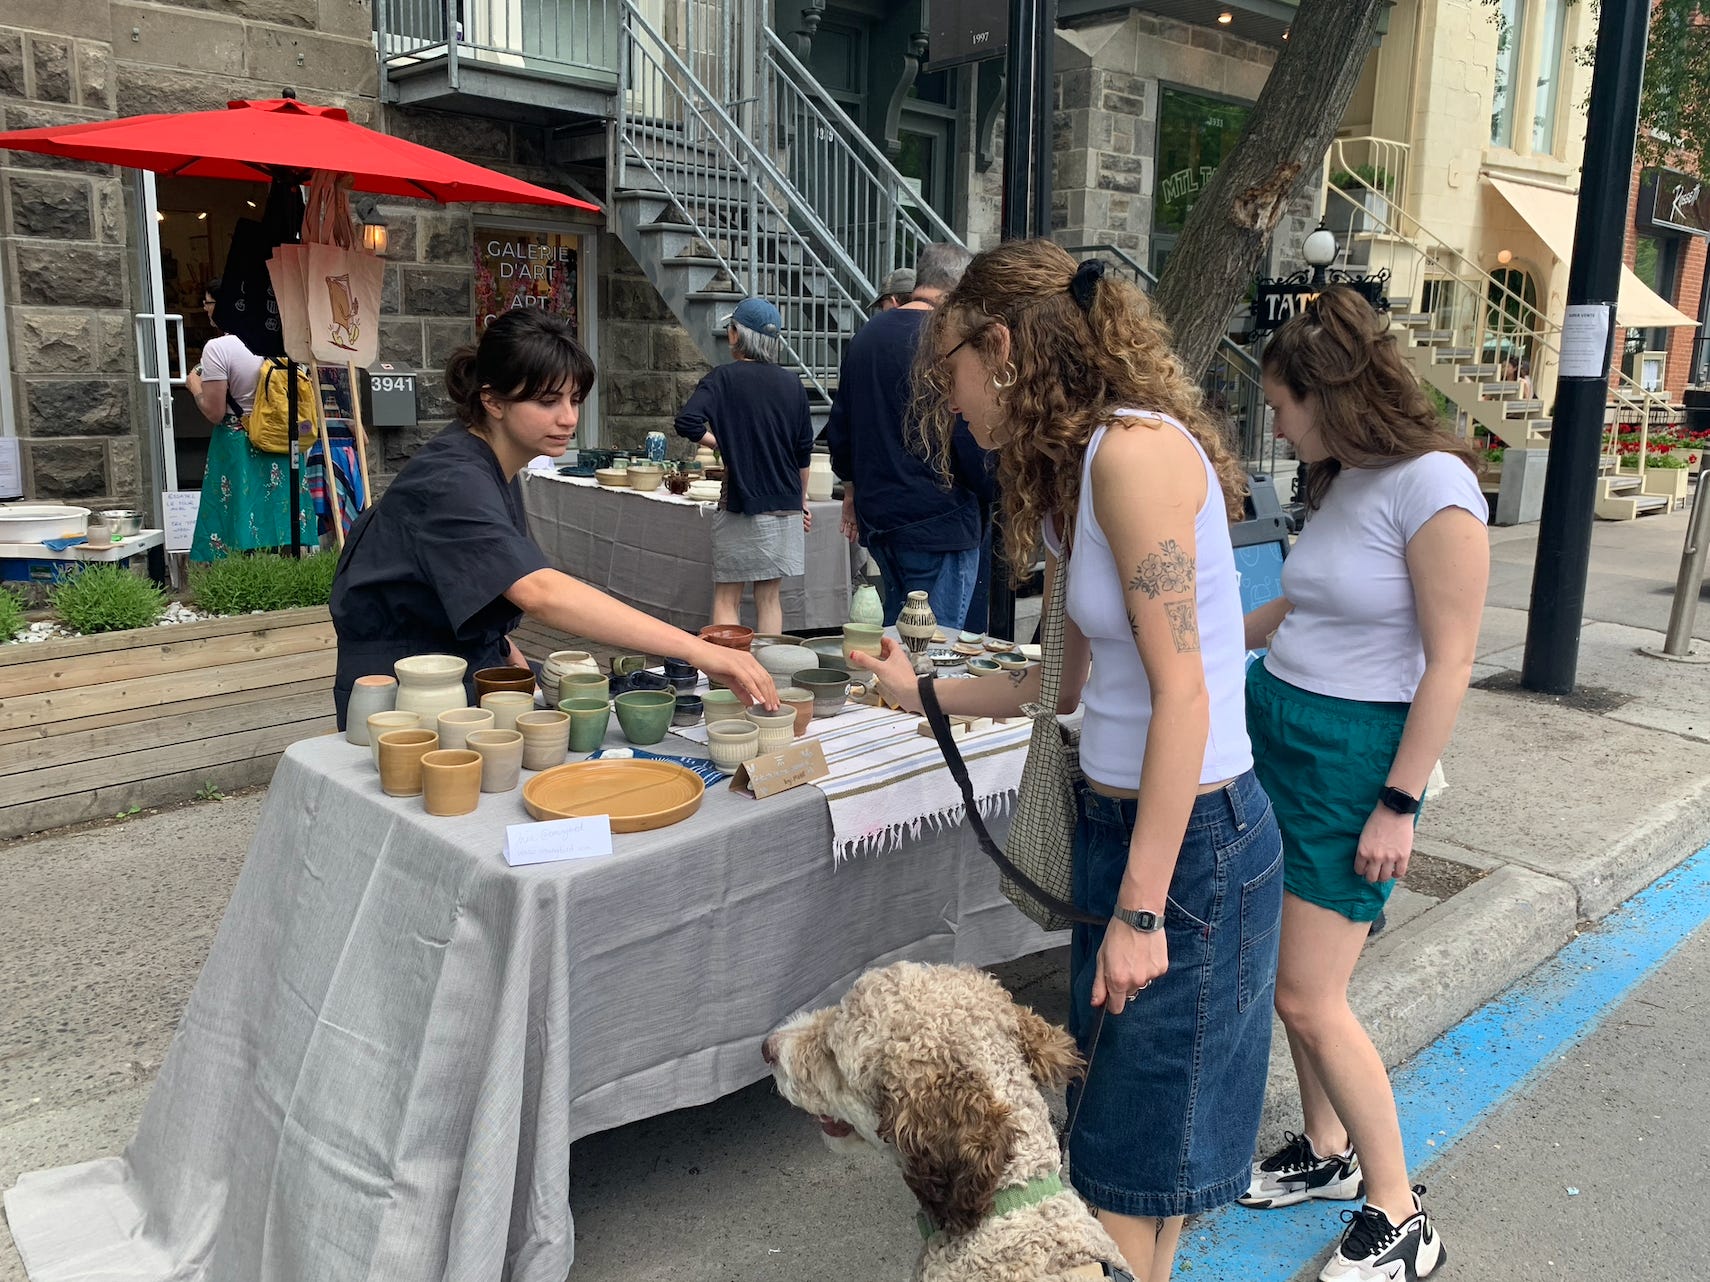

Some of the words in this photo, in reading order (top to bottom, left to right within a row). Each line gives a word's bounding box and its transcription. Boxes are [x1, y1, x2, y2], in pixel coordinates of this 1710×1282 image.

[972, 31, 990, 45] 1997
[1162, 168, 1199, 204] MTL
[487, 239, 569, 262] GALERIE
[500, 262, 557, 281] D'ART
[1265, 292, 1321, 321] TAT
[371, 376, 413, 392] 3941
